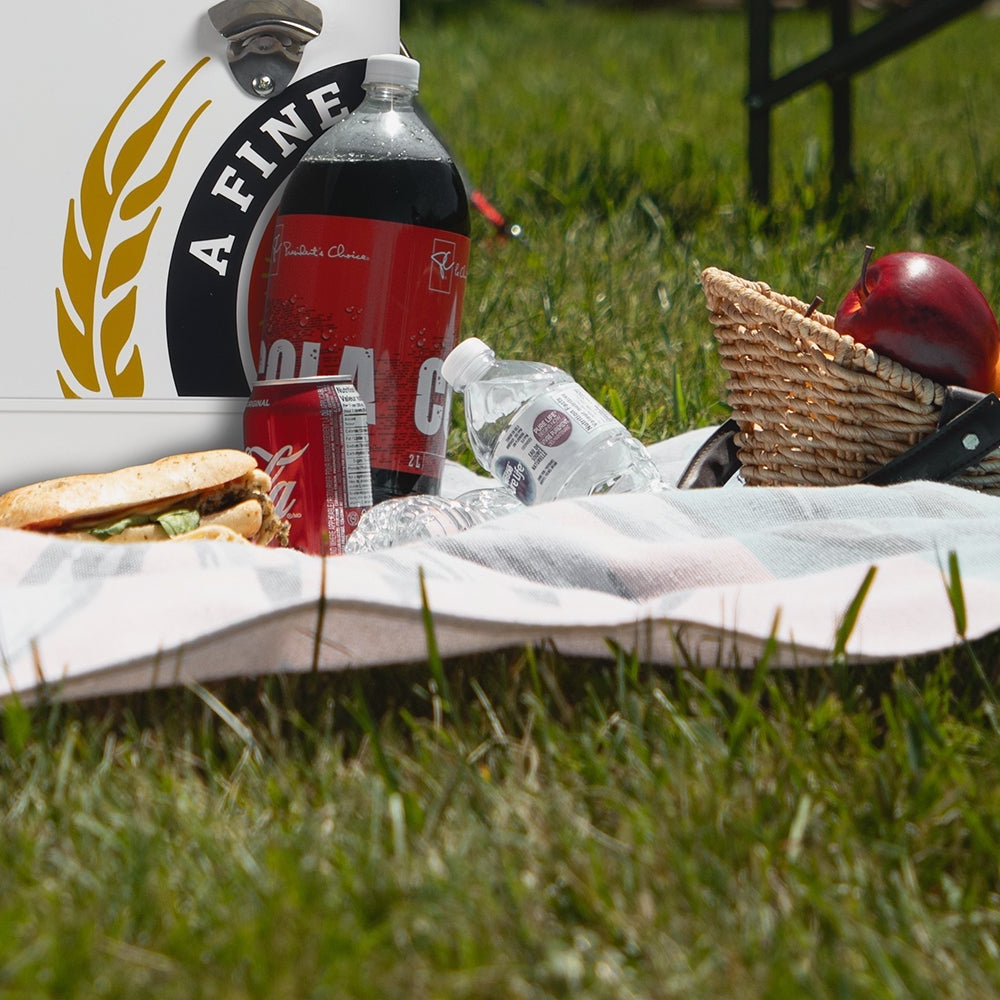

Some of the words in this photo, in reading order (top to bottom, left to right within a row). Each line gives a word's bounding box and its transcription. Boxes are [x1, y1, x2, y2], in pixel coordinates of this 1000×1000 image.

[211, 82, 350, 213] FINE
[189, 234, 235, 276] A
[328, 243, 367, 260] Choice
[533, 420, 548, 434] PURE
[544, 411, 557, 423] LIFE
